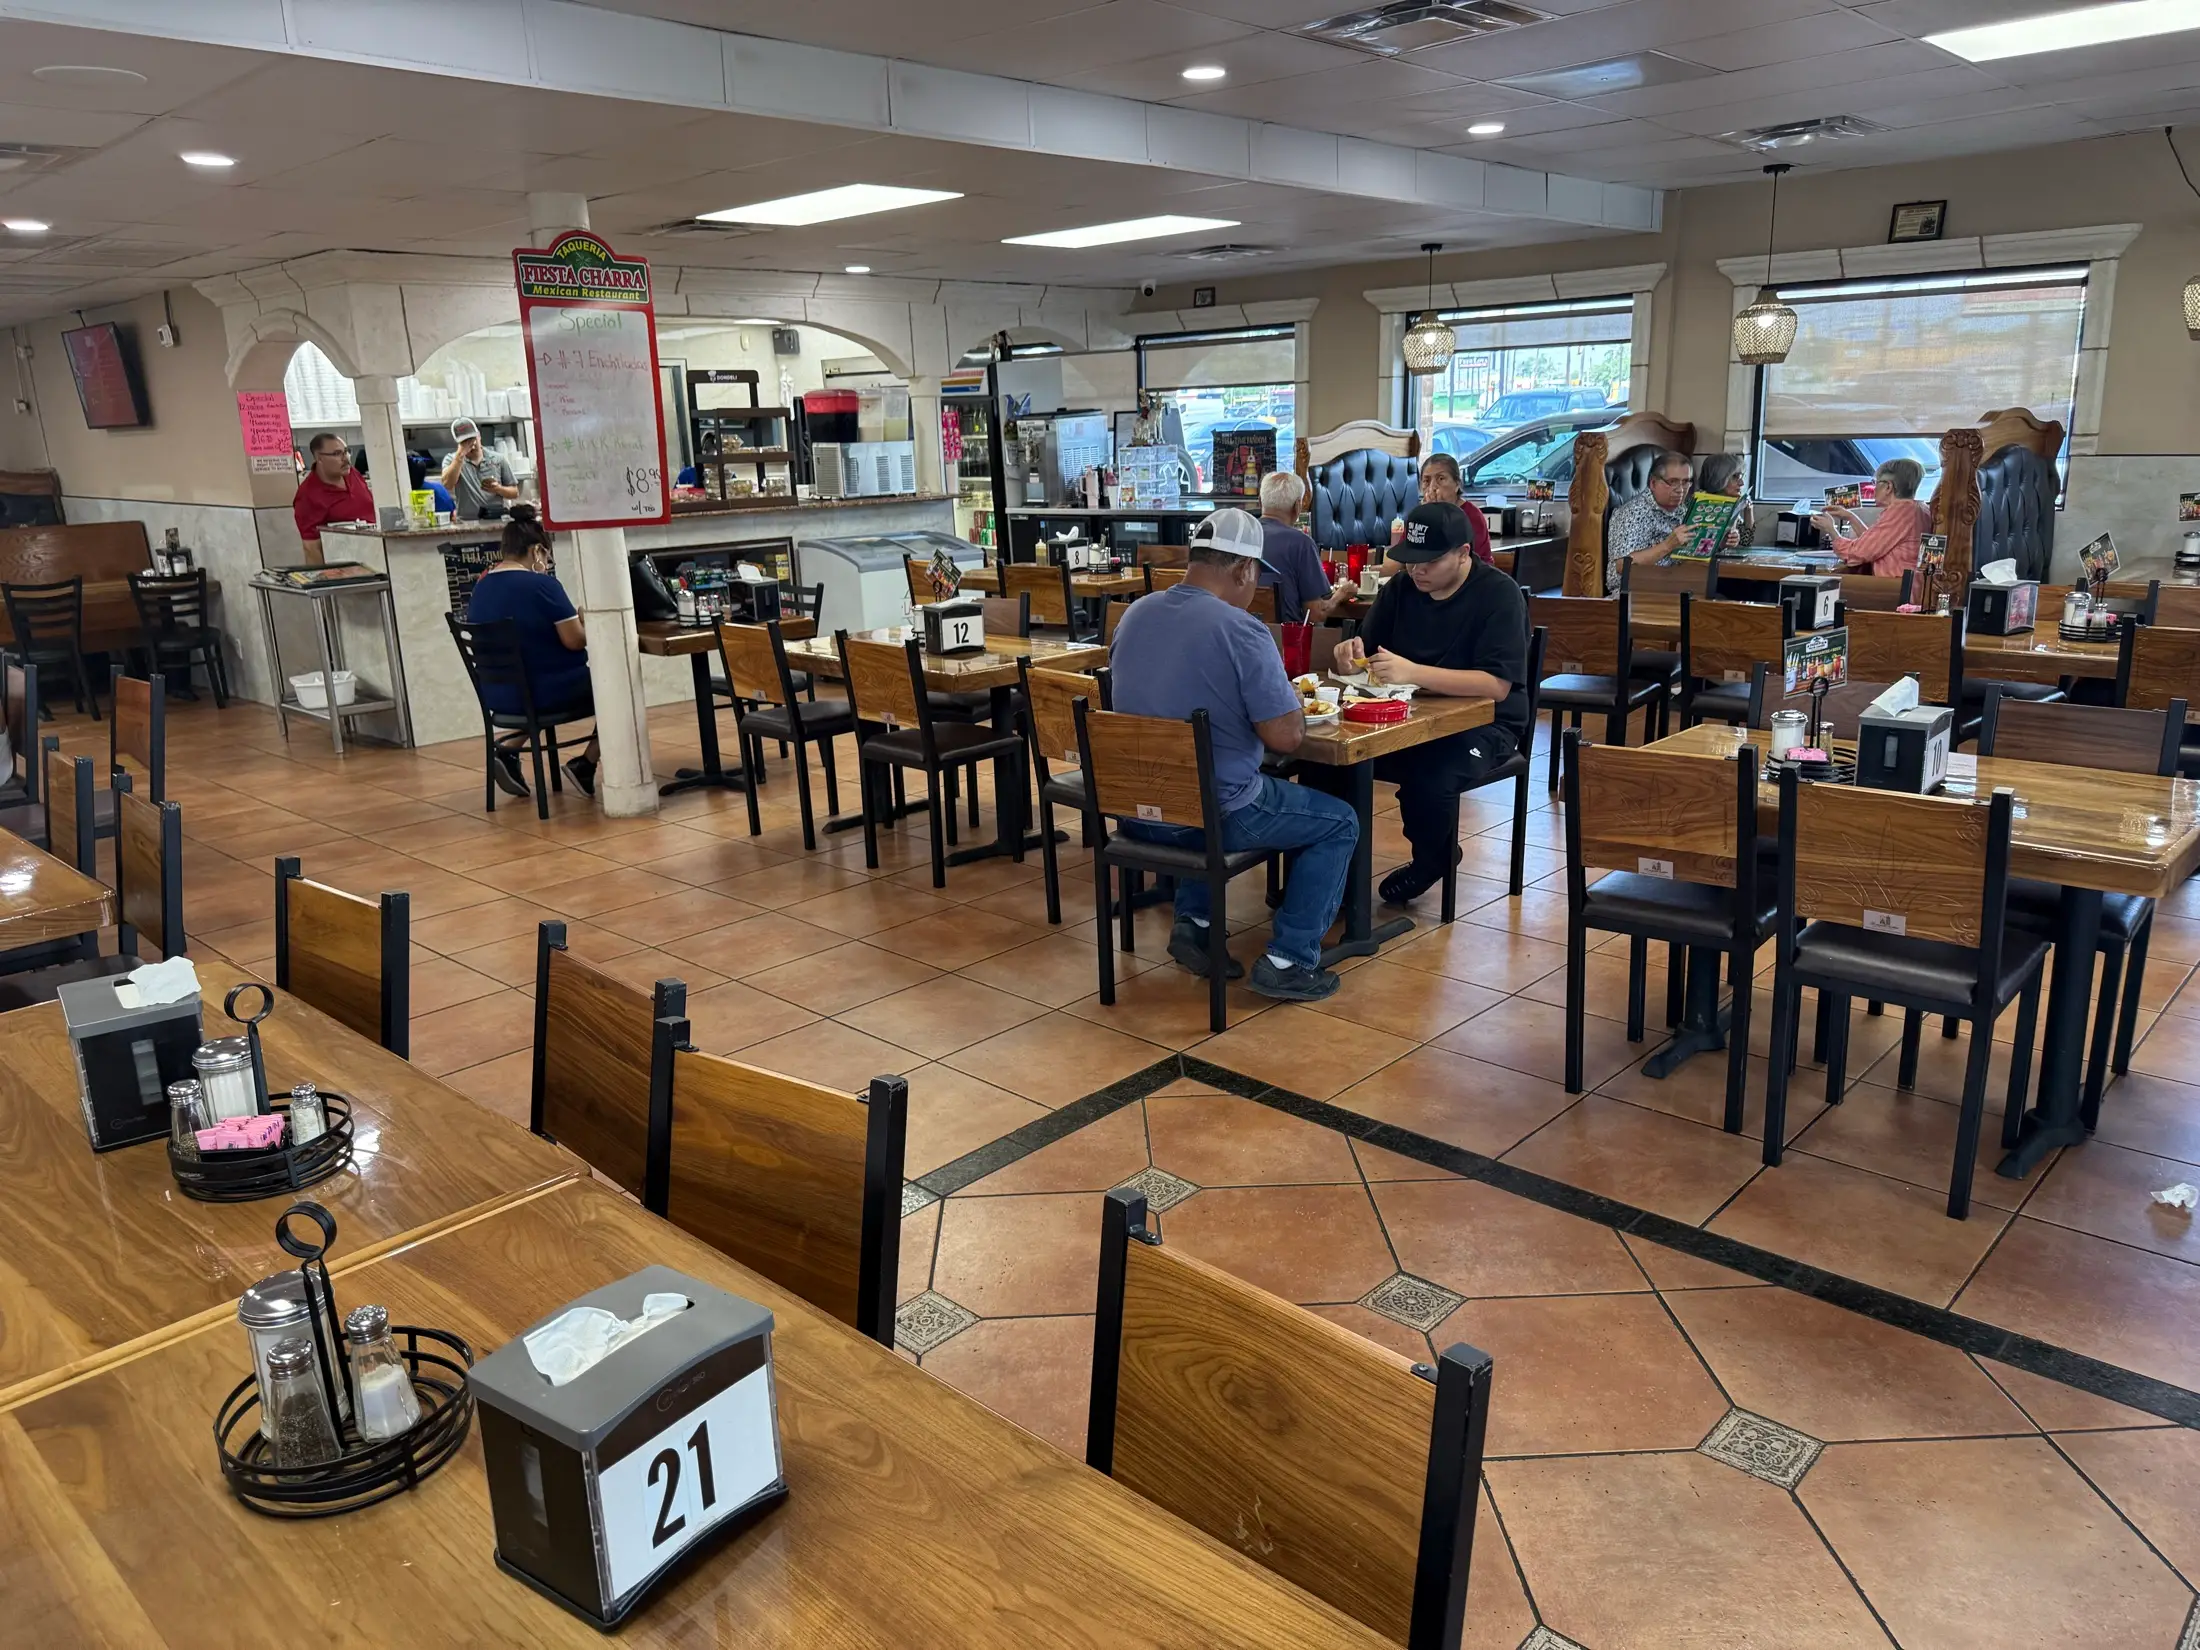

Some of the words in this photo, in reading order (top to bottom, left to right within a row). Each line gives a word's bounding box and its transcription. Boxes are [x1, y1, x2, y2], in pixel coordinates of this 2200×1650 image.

[556, 241, 607, 261] TAQUERIA
[521, 264, 579, 286] FIESTA
[579, 267, 645, 291] CHARRA
[532, 285, 579, 297] Mexican
[581, 288, 640, 300] Restaurant
[559, 309, 622, 337] Special
[588, 349, 648, 371] Enchiladas
[1074, 550, 1080, 565] 8
[1823, 595, 1830, 617] 6
[953, 622, 970, 644] 12
[1931, 739, 1942, 777] 10
[647, 1419, 716, 1550] 21
